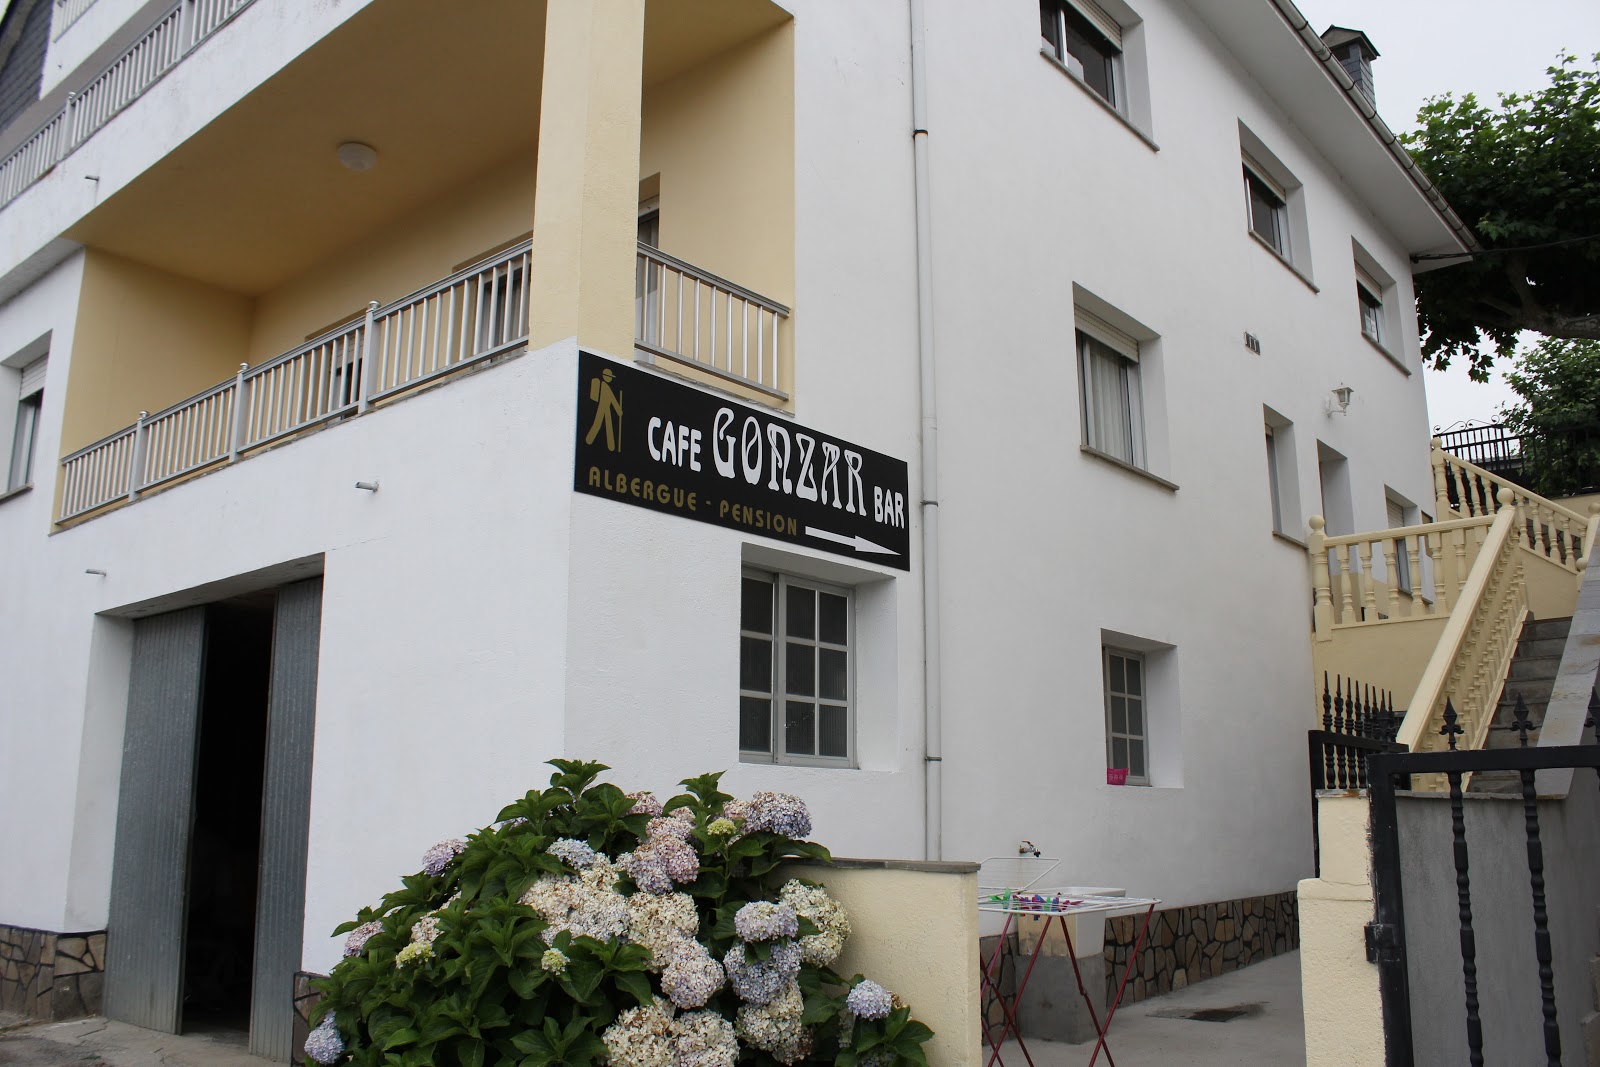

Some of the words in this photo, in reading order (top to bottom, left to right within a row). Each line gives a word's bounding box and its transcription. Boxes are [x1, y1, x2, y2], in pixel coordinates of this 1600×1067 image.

[588, 466, 697, 511] ALBERGUE
[719, 500, 797, 536] PENSION
[648, 416, 702, 472] CAFE
[713, 407, 866, 517] GONZAR
[874, 485, 905, 529] BAR
